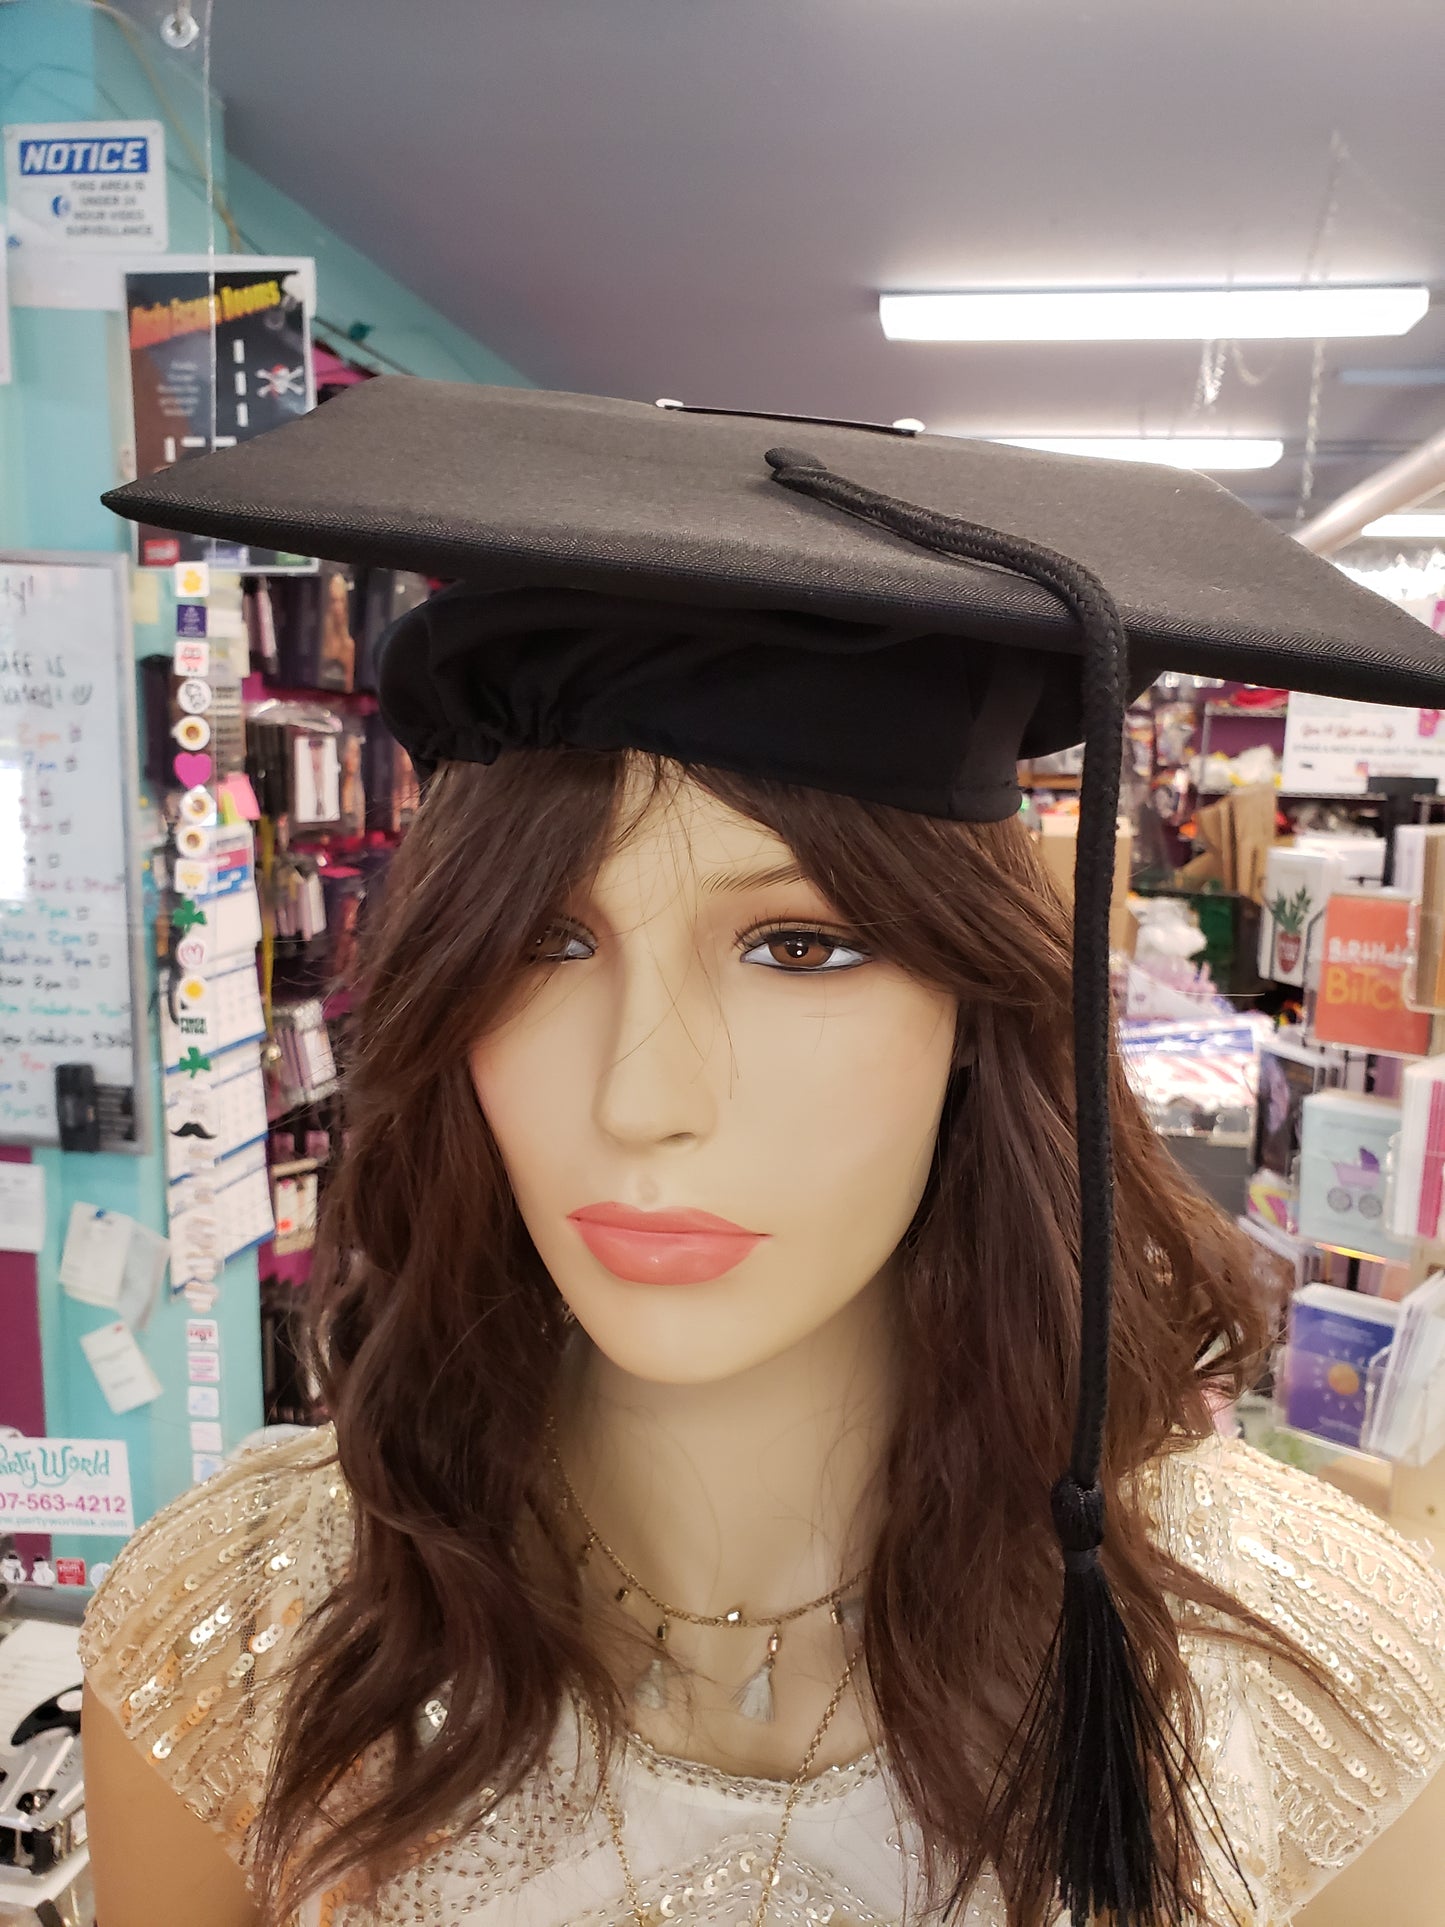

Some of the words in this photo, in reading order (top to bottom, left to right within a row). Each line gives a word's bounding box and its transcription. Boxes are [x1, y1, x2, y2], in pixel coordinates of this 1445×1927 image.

[23, 141, 144, 172] NOTICE
[100, 180, 131, 191] AREA
[80, 195, 120, 205] UNDER
[66, 224, 152, 236] SURVEILLANCE
[38, 1446, 110, 1479] World
